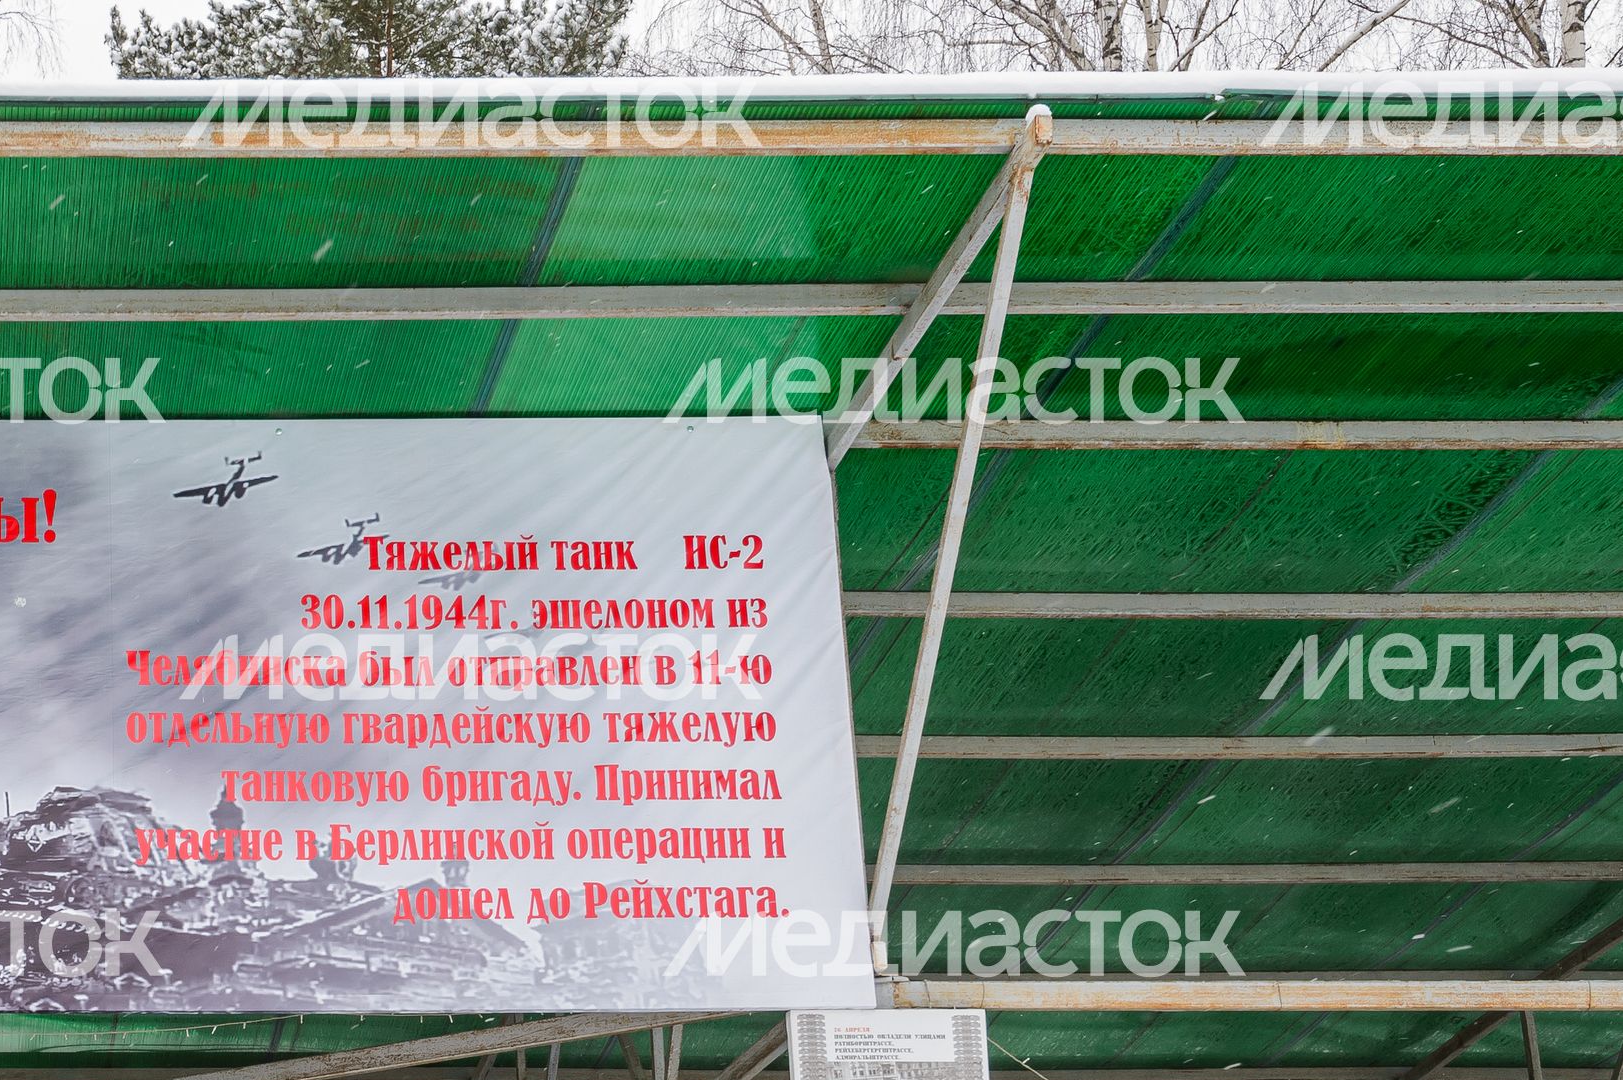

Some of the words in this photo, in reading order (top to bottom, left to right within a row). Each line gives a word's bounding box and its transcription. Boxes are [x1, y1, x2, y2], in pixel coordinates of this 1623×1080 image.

[363, 536, 538, 571] Тяжелый
[551, 541, 637, 571] танк
[684, 535, 763, 570] ИС-2
[301, 594, 518, 630] 30.11.1944г.
[531, 598, 714, 629] эшелоном
[727, 598, 767, 628] из
[126, 650, 346, 686] Челябинска
[360, 651, 432, 686] был
[448, 656, 641, 691] отправлен
[655, 656, 676, 685] в
[692, 651, 772, 685] 11-ю
[126, 712, 330, 749] отдельную
[343, 708, 590, 748] гвардейскую
[603, 712, 776, 747] тяжелую
[221, 770, 409, 807] танковую
[422, 765, 581, 807] бригаду.
[594, 764, 781, 806] Принимал
[135, 828, 282, 866] участие
[296, 830, 318, 860] в
[330, 823, 553, 865] Берлинской
[567, 827, 750, 864] операции
[764, 827, 785, 858] и
[393, 888, 513, 924] дошел
[527, 888, 570, 923] до
[584, 881, 789, 919] Рейхстага.
